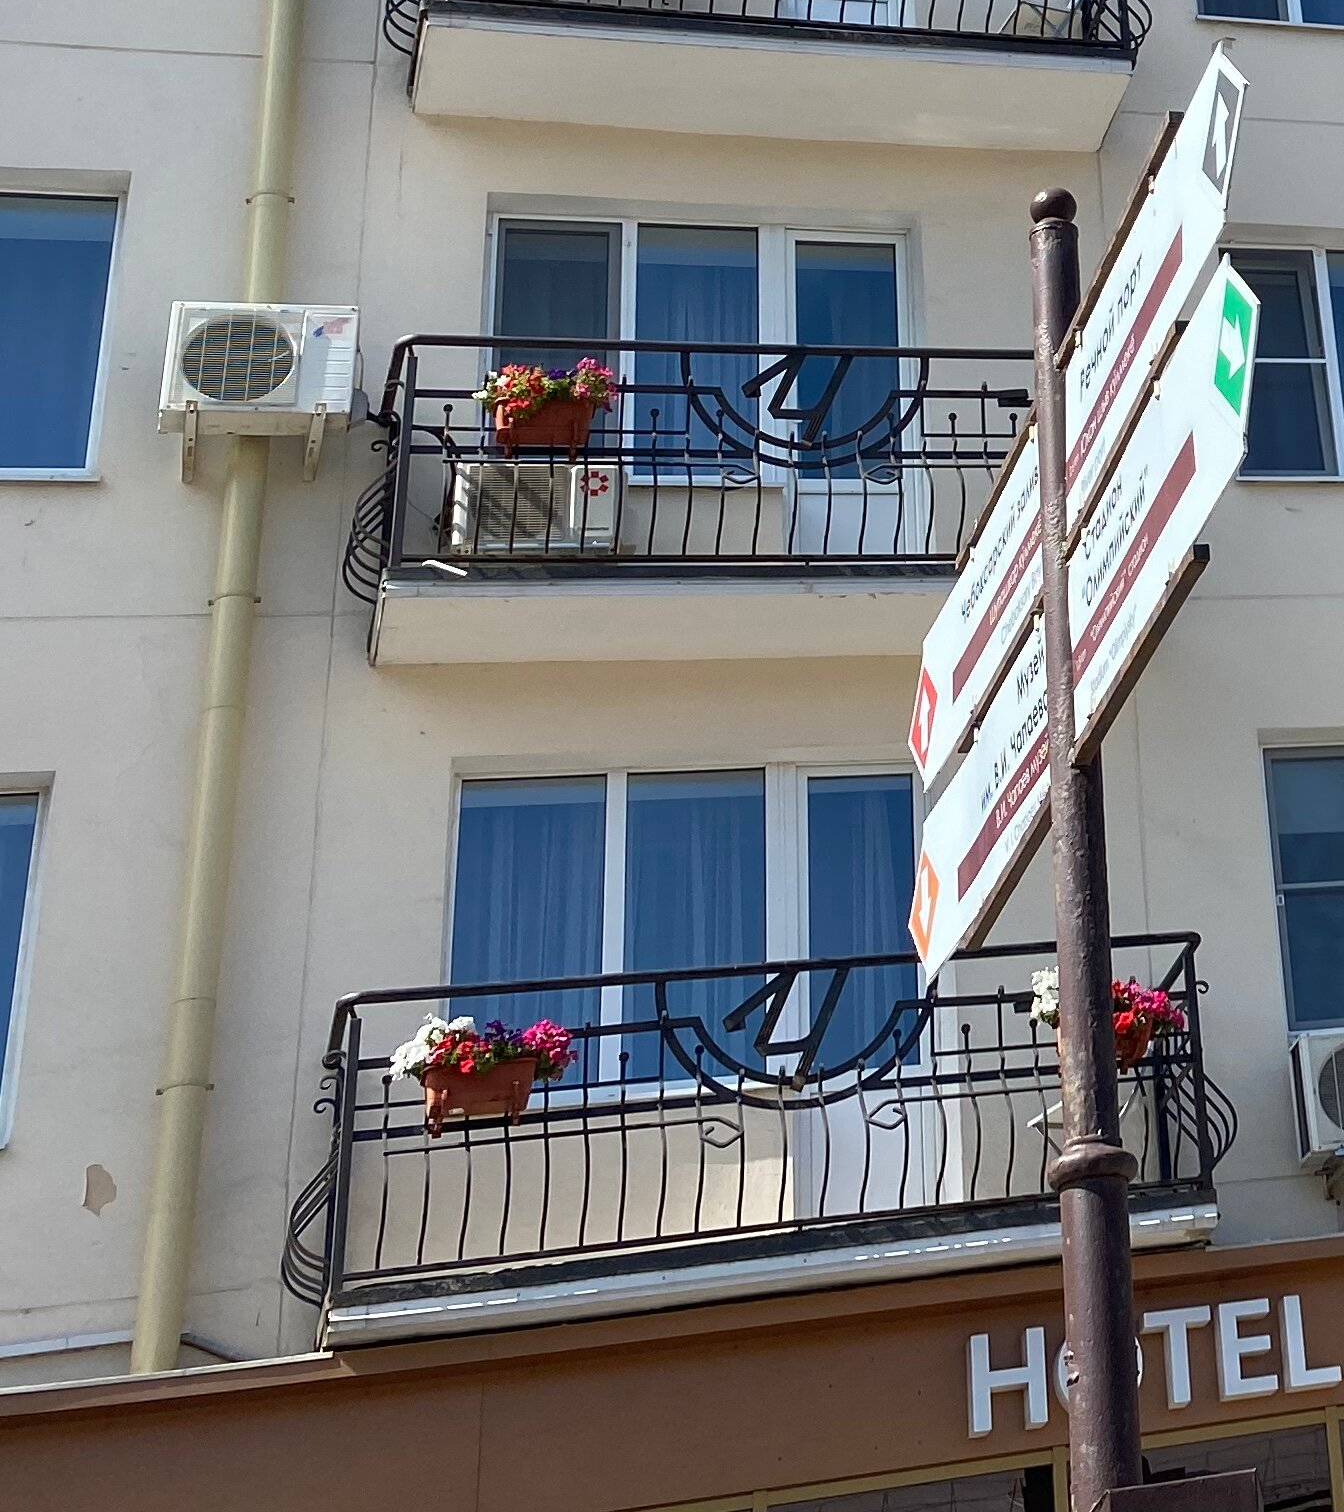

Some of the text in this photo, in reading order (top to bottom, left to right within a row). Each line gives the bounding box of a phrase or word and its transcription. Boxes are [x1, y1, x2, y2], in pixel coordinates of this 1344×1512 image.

[1079, 254, 1143, 402] Речной порт
[961, 506, 1017, 624] Чебоксарский
[1083, 474, 1123, 561] Стадион
[1016, 635, 1045, 705] Музей
[966, 1294, 1343, 1439] HTEL
